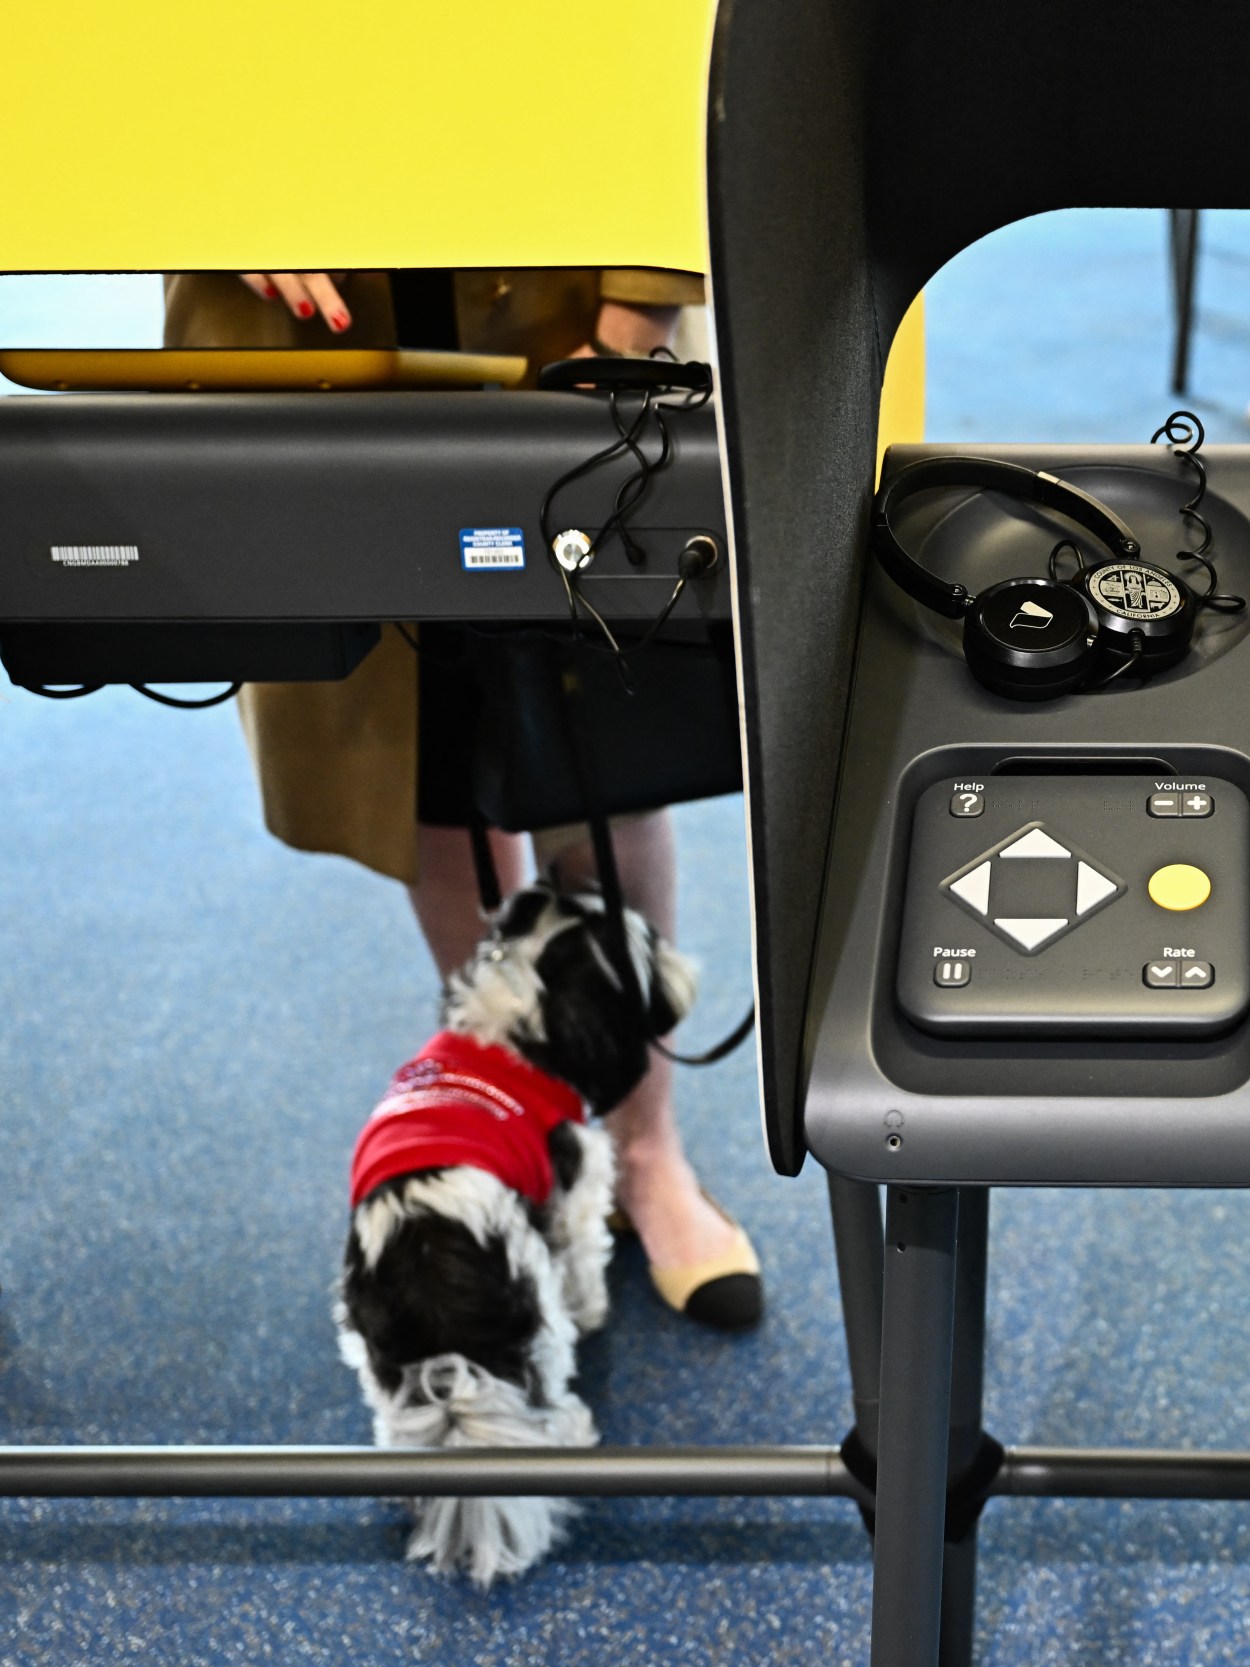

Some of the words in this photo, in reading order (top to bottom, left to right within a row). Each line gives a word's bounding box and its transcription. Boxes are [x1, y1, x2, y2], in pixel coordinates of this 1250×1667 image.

[1094, 566, 1115, 580] COUNTY
[1144, 569, 1173, 588] ANGELES
[1116, 608, 1160, 619] CALIFORNIA
[953, 782, 985, 793] Help
[1154, 781, 1206, 791] Volume
[933, 946, 977, 958] Pause
[1163, 946, 1195, 958] Rate
